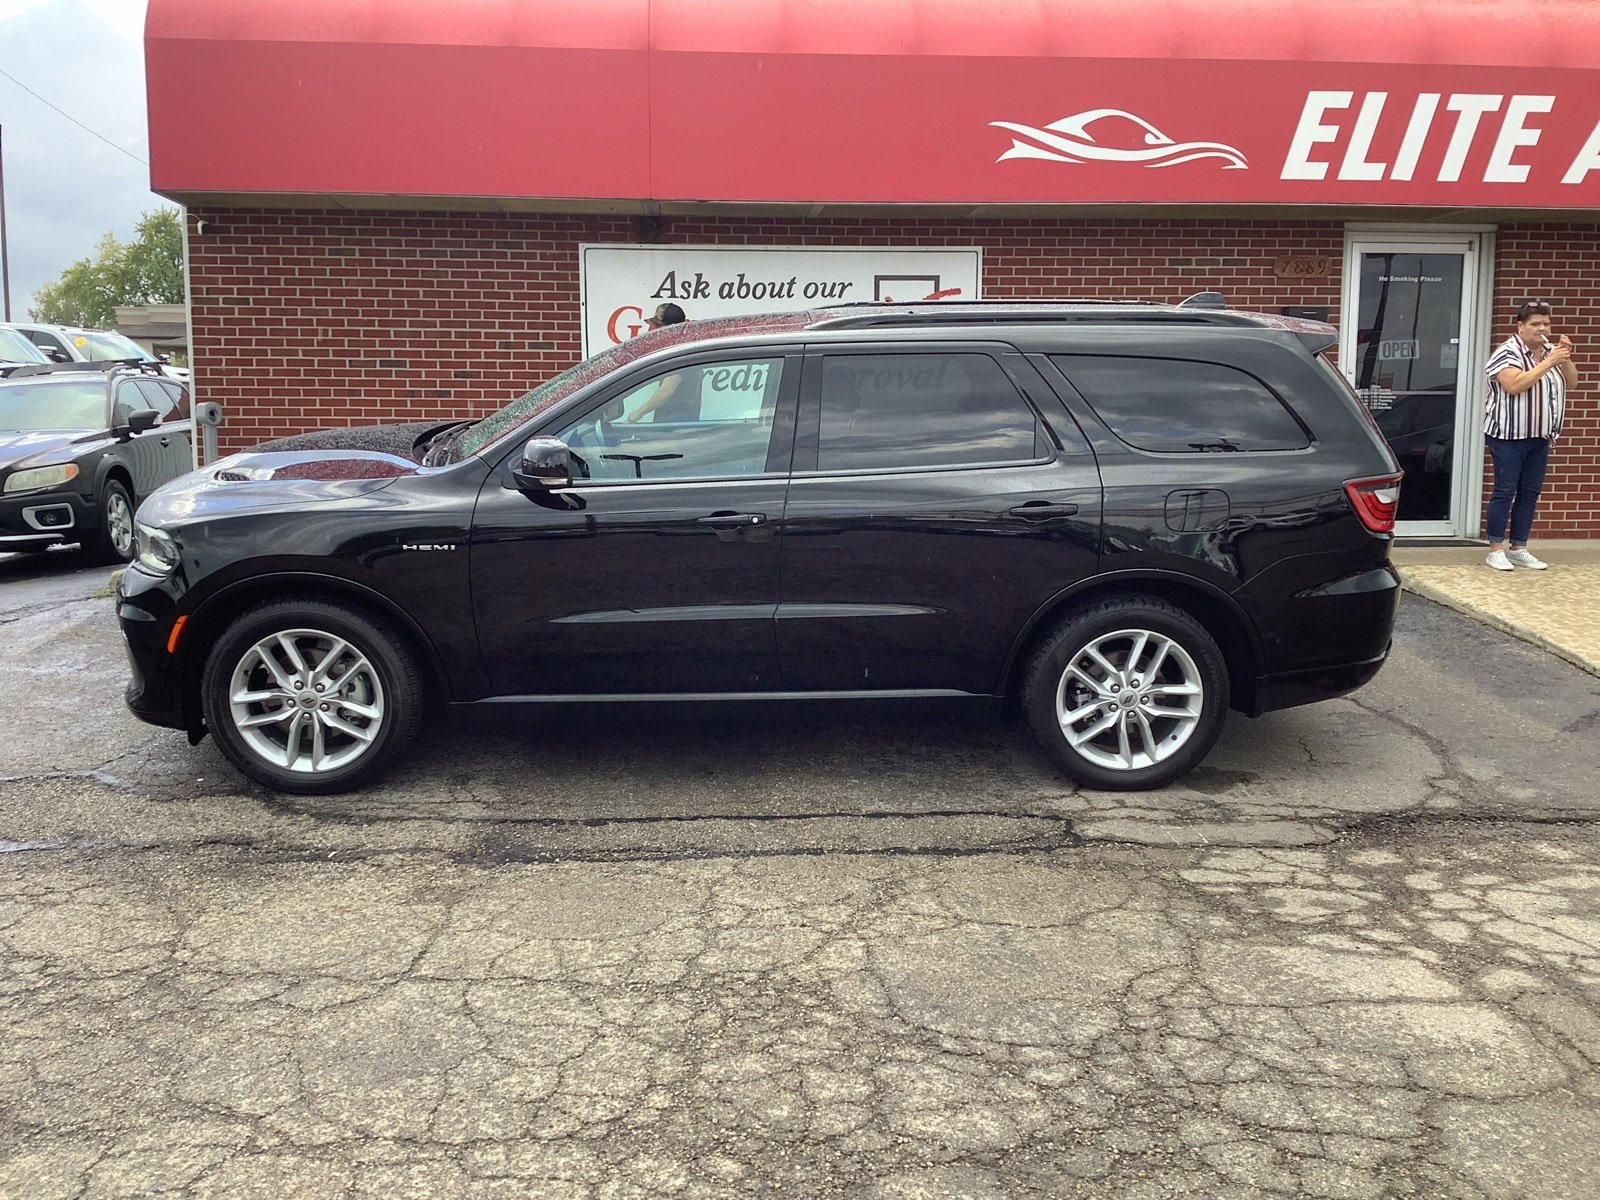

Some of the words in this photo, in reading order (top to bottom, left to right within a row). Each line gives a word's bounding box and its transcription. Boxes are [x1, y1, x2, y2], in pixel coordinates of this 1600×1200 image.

[1279, 90, 1556, 183] ELITE
[1282, 259, 1327, 275] 7889
[650, 270, 711, 300] Ask
[718, 273, 797, 300] about
[803, 281, 853, 300] our
[1382, 341, 1417, 358] OPEN
[701, 364, 769, 392] redi
